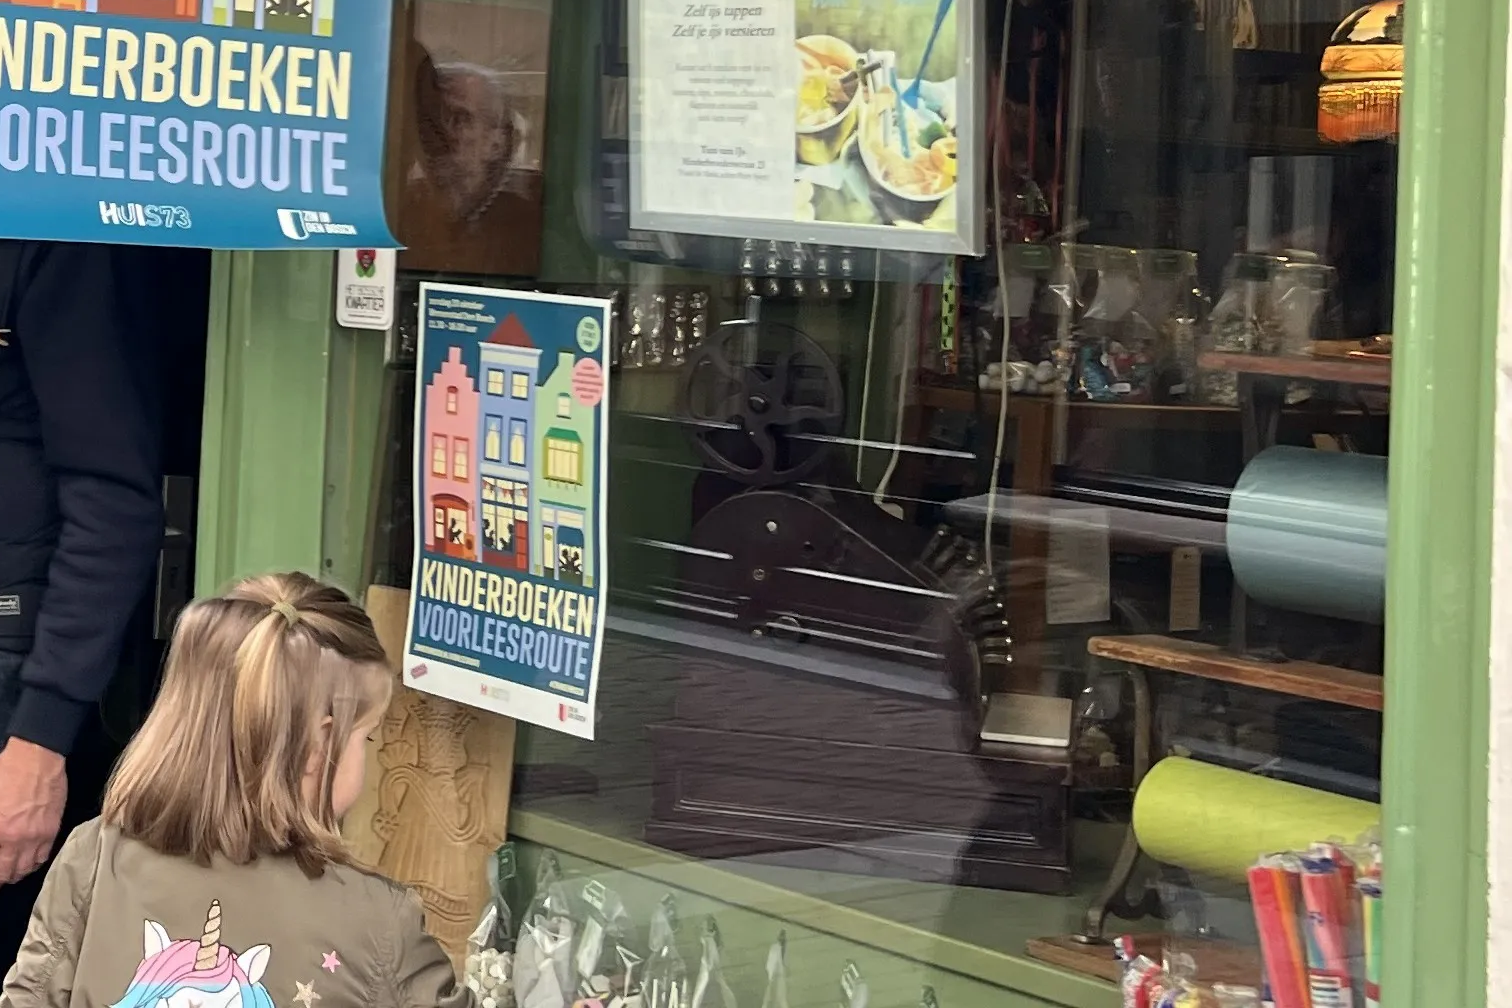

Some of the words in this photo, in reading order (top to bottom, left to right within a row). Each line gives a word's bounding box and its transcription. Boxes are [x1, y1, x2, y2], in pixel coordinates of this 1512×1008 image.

[98, 200, 192, 229] HUIS73
[420, 556, 595, 639] KINDERBOEKEN
[417, 600, 590, 682] VOORLEESROUTE
